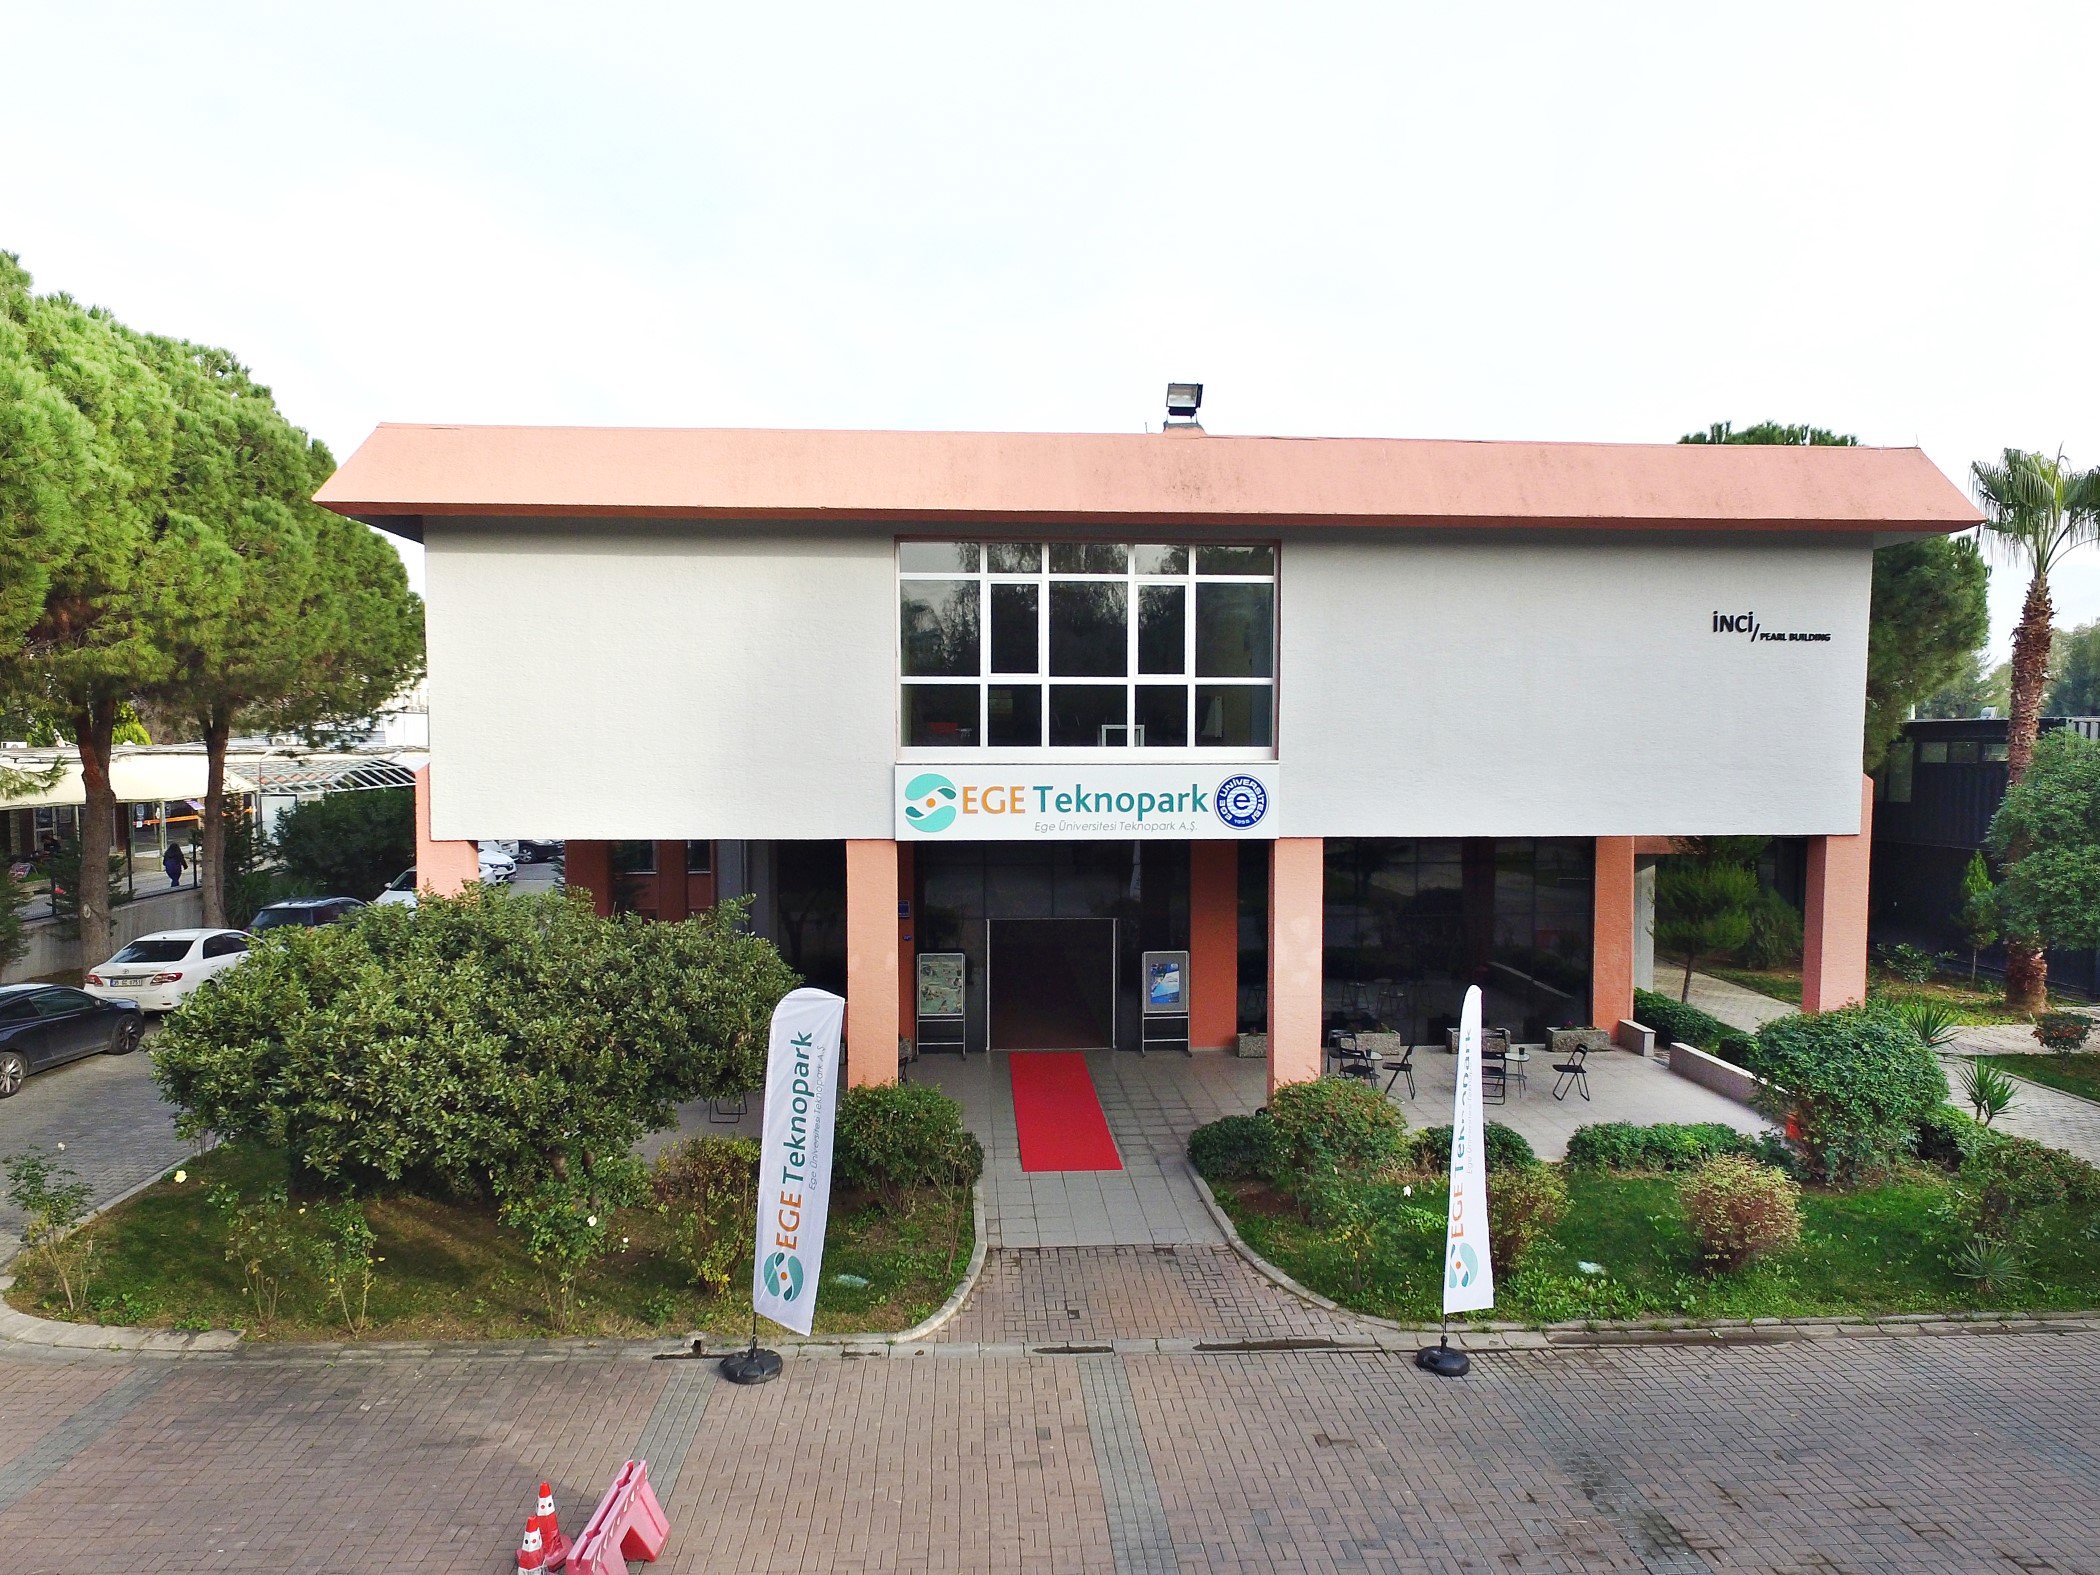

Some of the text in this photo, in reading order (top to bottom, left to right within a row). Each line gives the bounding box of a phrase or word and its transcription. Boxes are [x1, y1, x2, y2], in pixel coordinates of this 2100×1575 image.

[1760, 632, 1832, 641] PEARL BUILDING
[962, 783, 1209, 821] EGE Teknopark
[1034, 819, 1198, 833] Ege Üniversitesi Teknopark A.Ş.
[775, 1030, 815, 1251] EGE Teknopark
[808, 1171, 817, 1191] Ege
[813, 1064, 824, 1114] Teknopark
[1450, 1182, 1464, 1239] EGE
